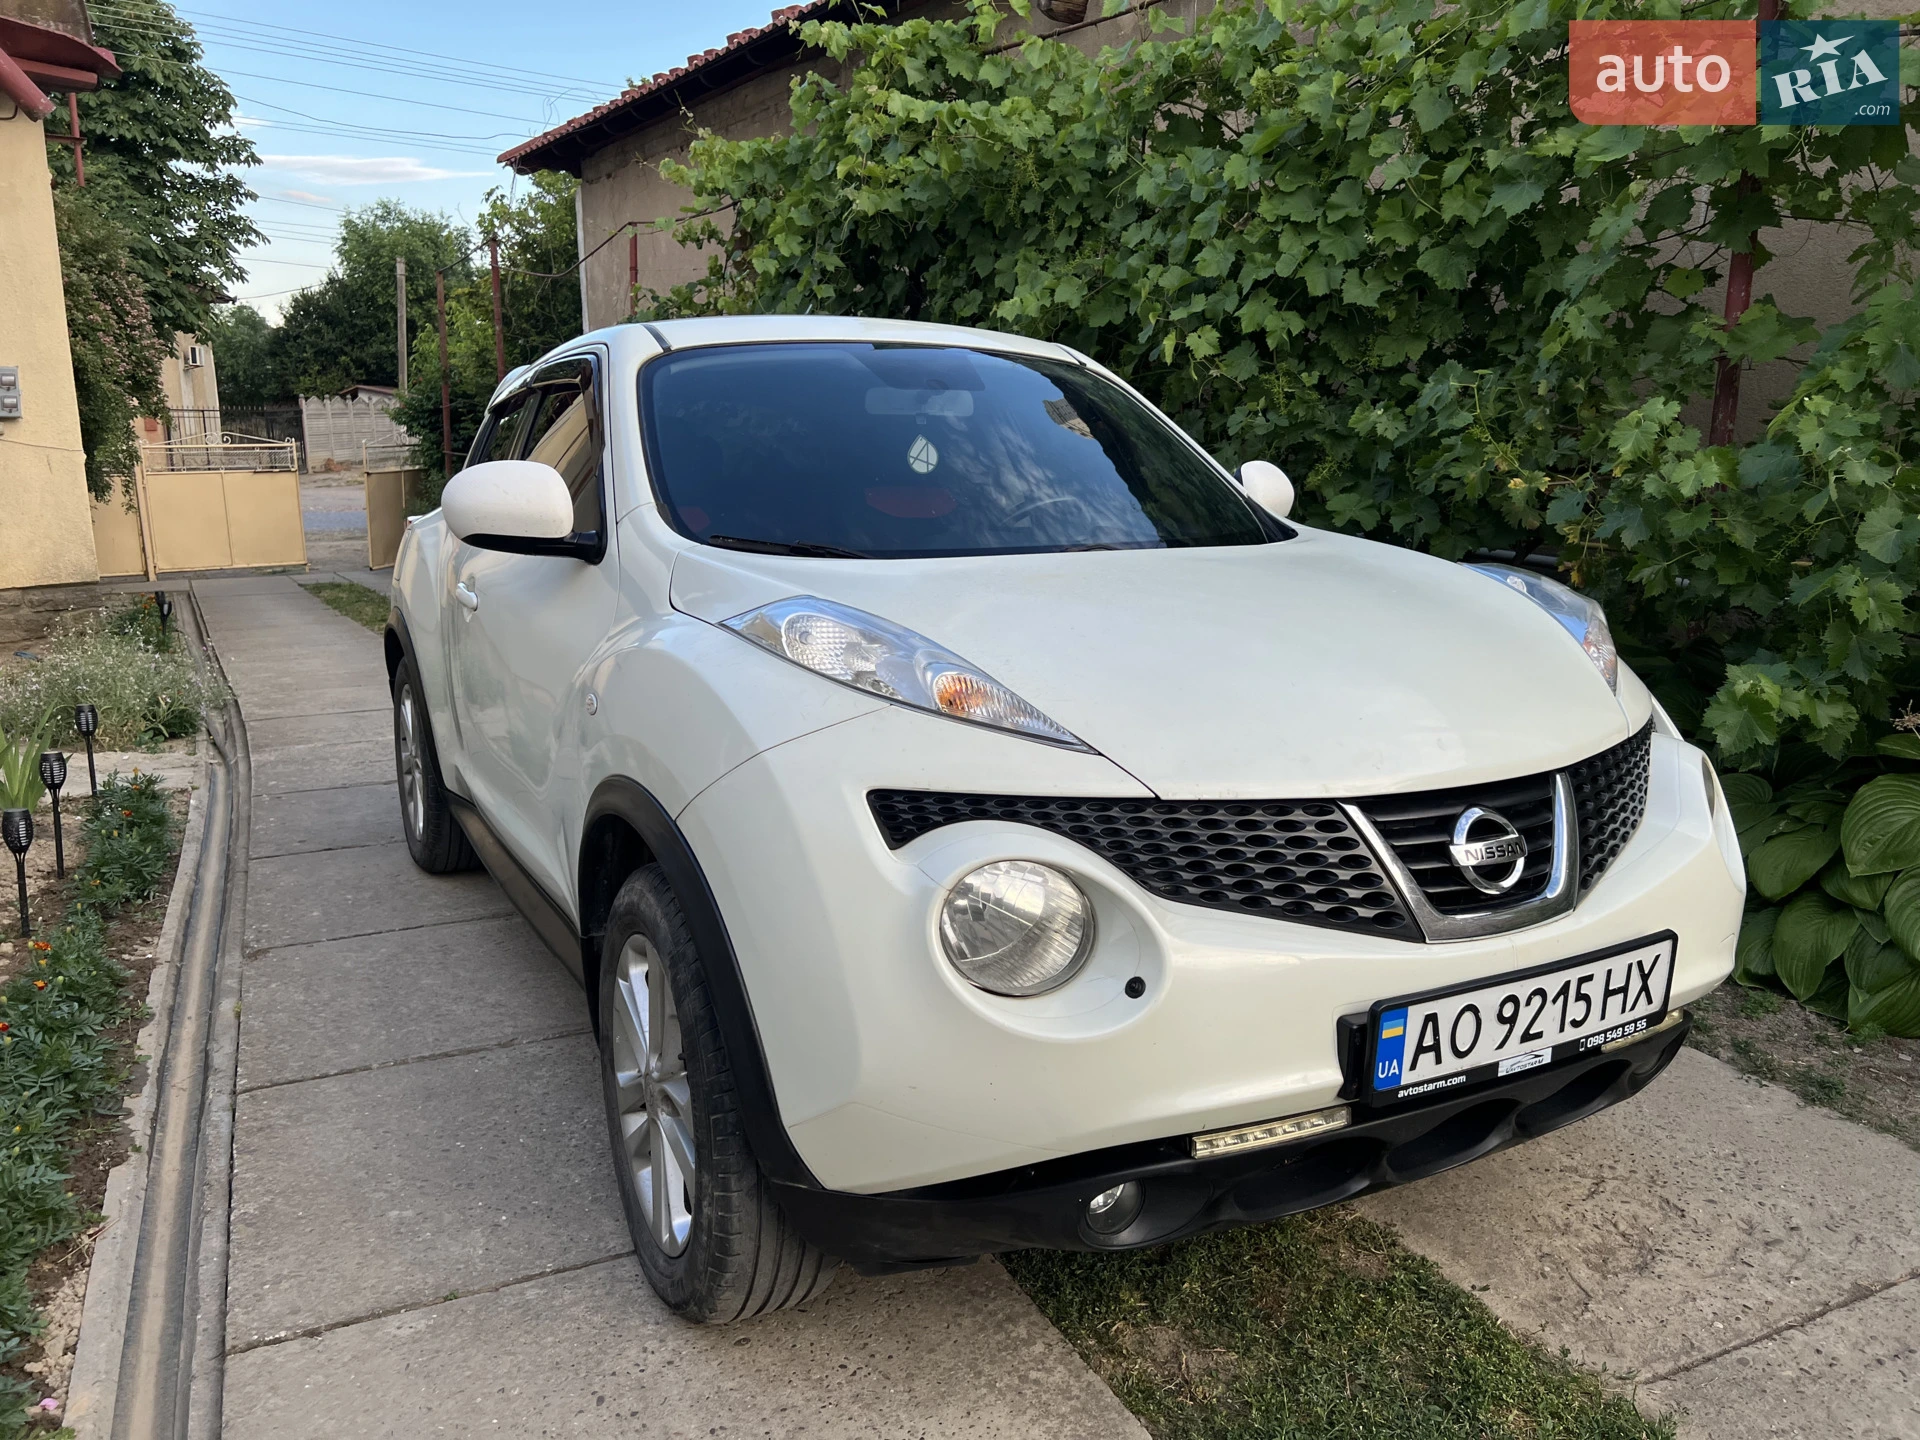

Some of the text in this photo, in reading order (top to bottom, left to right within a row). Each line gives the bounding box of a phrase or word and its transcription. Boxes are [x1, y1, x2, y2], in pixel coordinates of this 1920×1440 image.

[1464, 841, 1524, 861] NISSAN
[1587, 1019, 1647, 1048] 098 549 59 55
[1378, 1059, 1399, 1078] UA
[1398, 1075, 1466, 1098] avtostarm.com
